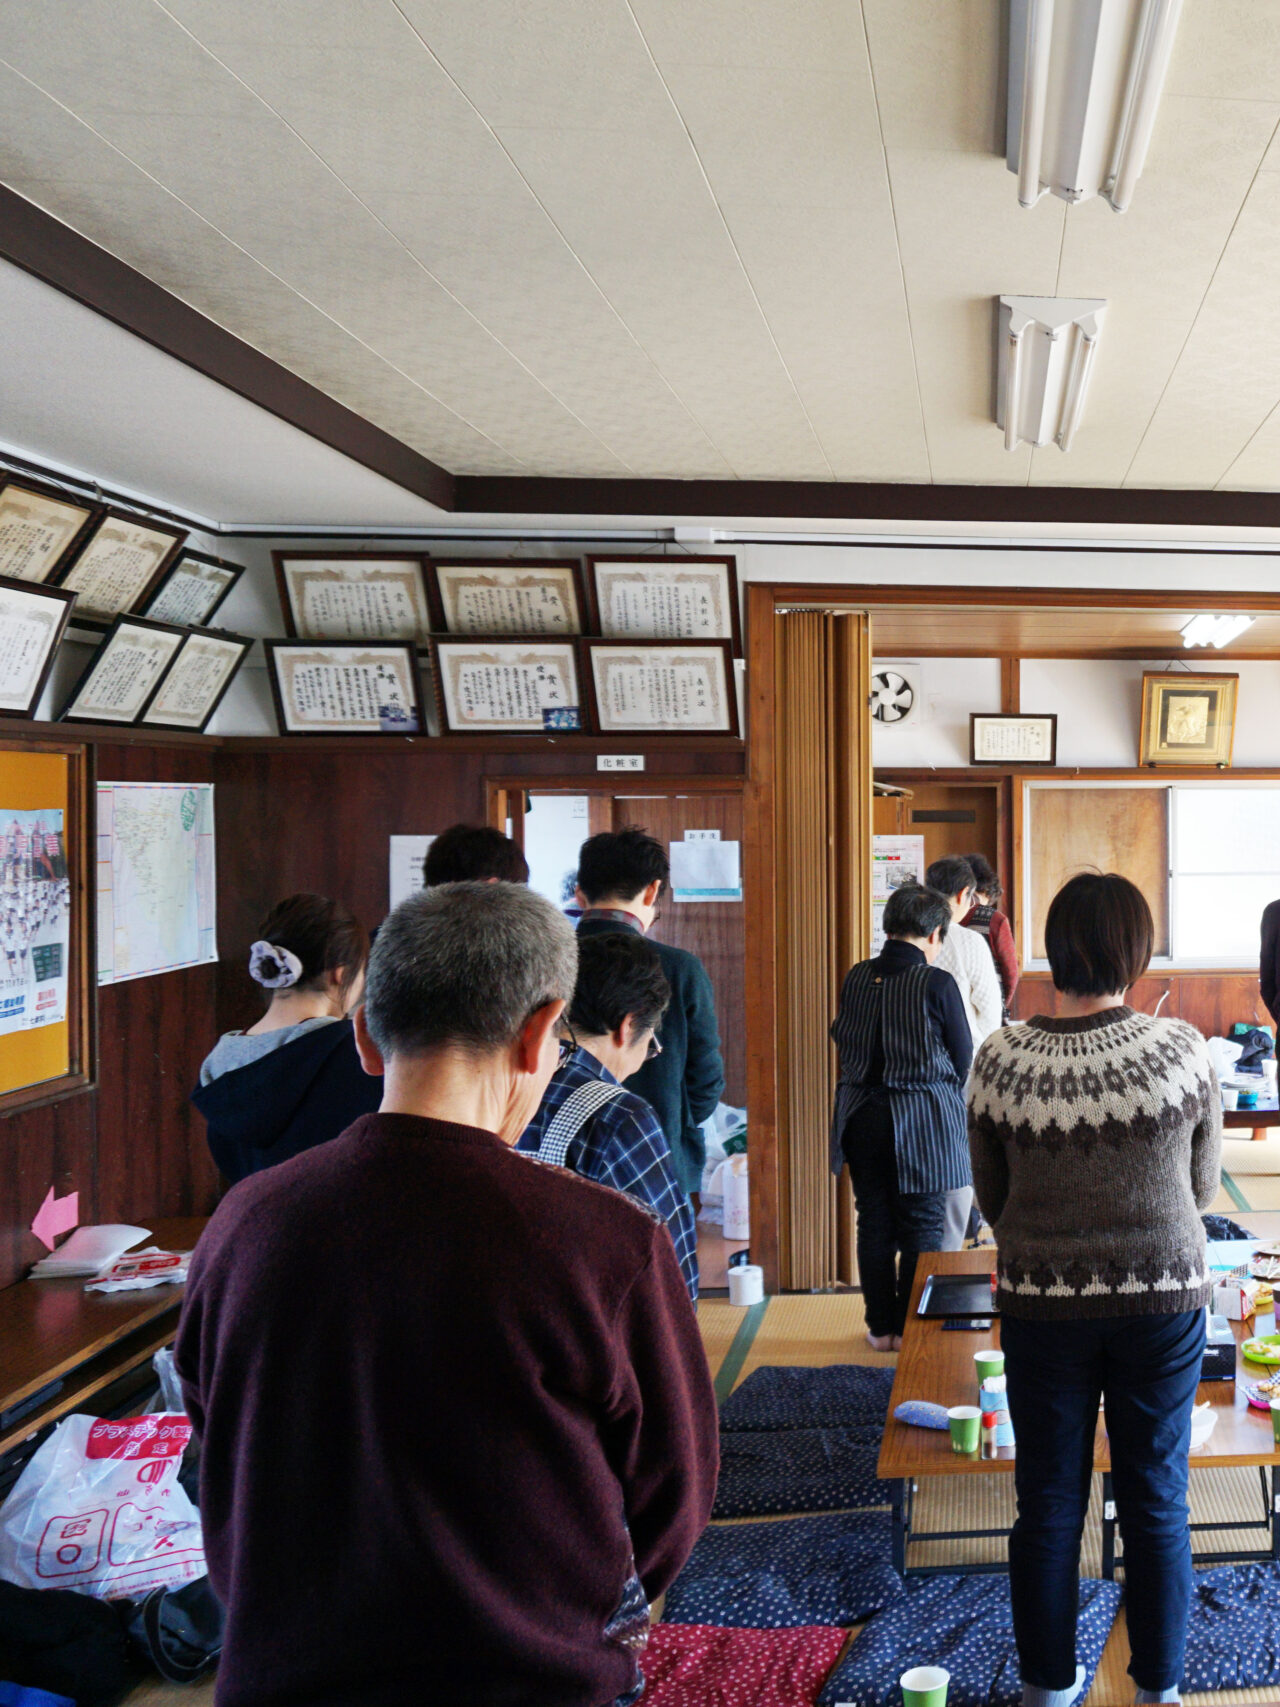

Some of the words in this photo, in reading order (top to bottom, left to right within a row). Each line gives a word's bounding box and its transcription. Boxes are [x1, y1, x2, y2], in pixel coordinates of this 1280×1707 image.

[386, 674, 400, 702] 賞状
[546, 674, 560, 700] 賞状
[603, 758, 639, 769] 化粧室
